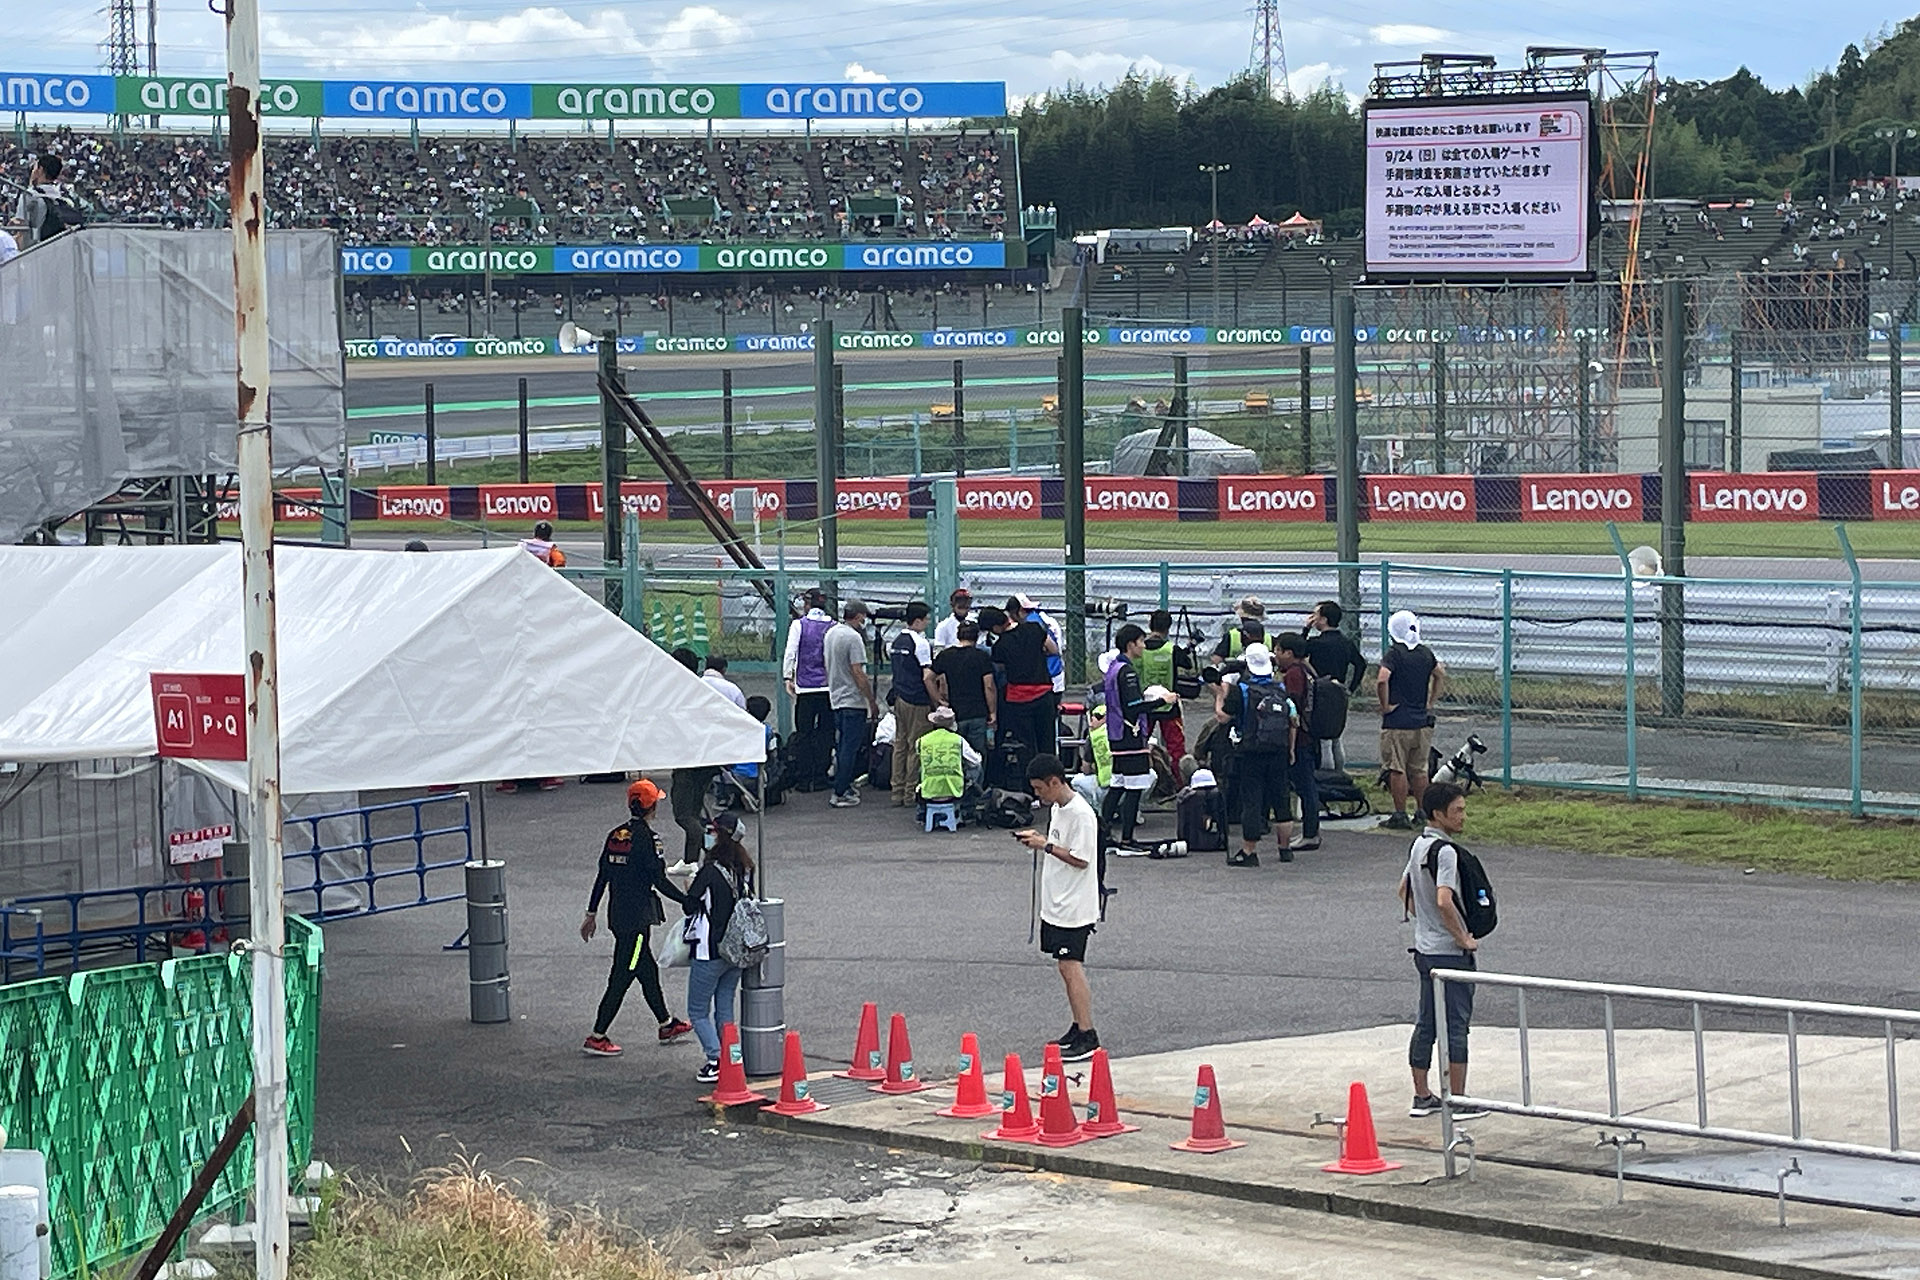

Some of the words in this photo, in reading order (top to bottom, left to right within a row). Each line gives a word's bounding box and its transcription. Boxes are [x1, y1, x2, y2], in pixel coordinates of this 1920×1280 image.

[350, 86, 507, 113] aramco
[557, 87, 715, 114] aramco
[766, 87, 924, 114] aramco
[427, 251, 537, 270] aramco
[571, 247, 682, 268] aramco
[717, 245, 828, 267] aramco
[862, 244, 973, 266] aramco
[655, 336, 728, 351] aramco
[839, 332, 914, 348] aramco
[933, 330, 1007, 346] aramco
[1120, 328, 1192, 343] aramco
[1216, 328, 1282, 343] aramco
[384, 341, 456, 356] aramco
[474, 339, 544, 355] aramco
[382, 494, 444, 516] Lenovo
[485, 492, 551, 514] Lenovo
[835, 491, 902, 511] enovo
[955, 486, 1034, 510] Lenovo
[1084, 486, 1170, 511] Lenovo
[1227, 485, 1316, 511] Lenovo
[1373, 485, 1467, 511] Lenovo
[1531, 484, 1633, 511] Lenovo
[1699, 483, 1807, 511] Lenovo
[167, 708, 184, 730] A1
[202, 714, 213, 735] P
[225, 714, 238, 736] Q
